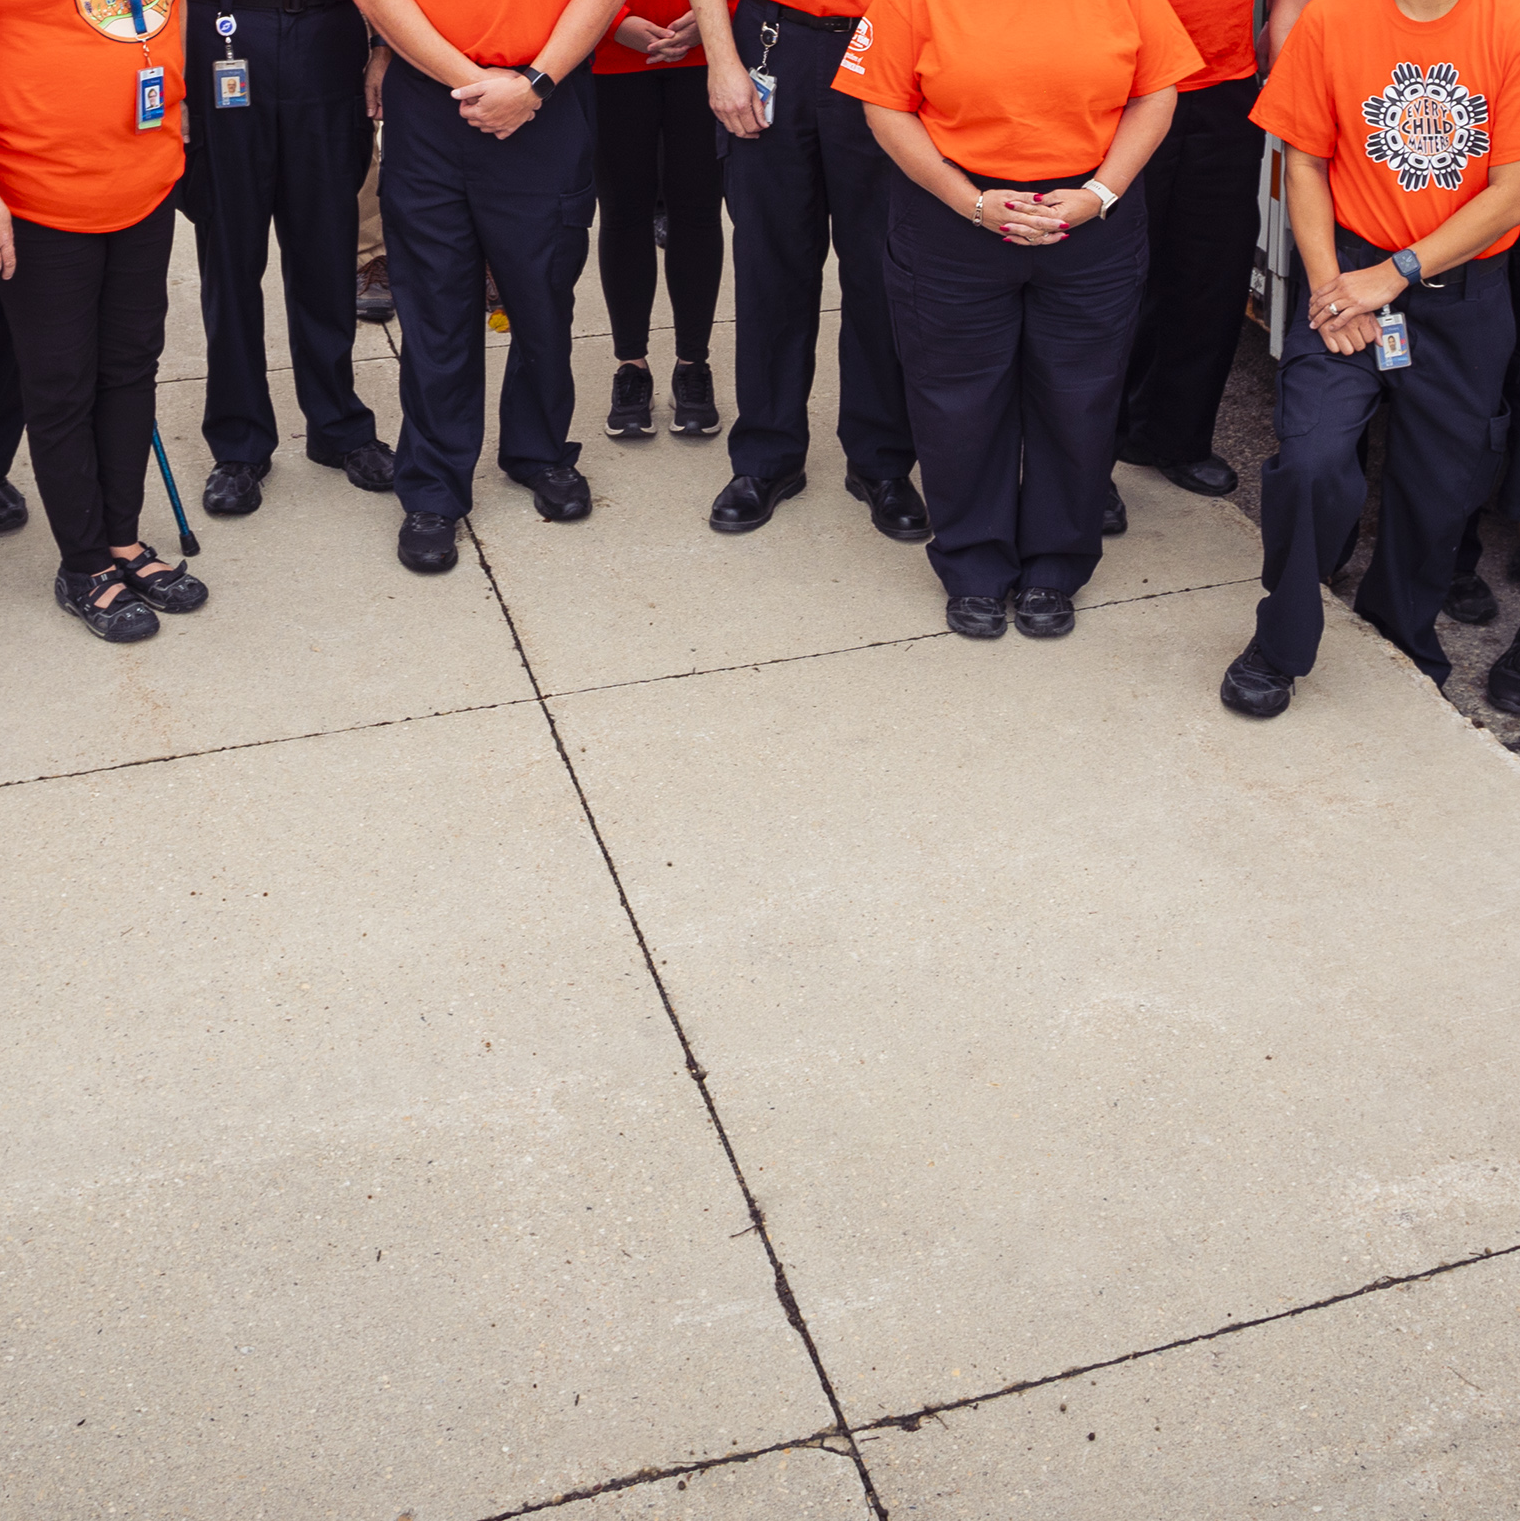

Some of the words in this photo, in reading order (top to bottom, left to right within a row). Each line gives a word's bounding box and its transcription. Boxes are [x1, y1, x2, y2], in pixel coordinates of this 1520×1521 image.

[1408, 99, 1447, 118] EVERY
[1402, 118, 1453, 134] CHILD
[1409, 136, 1449, 154] MATTERS
